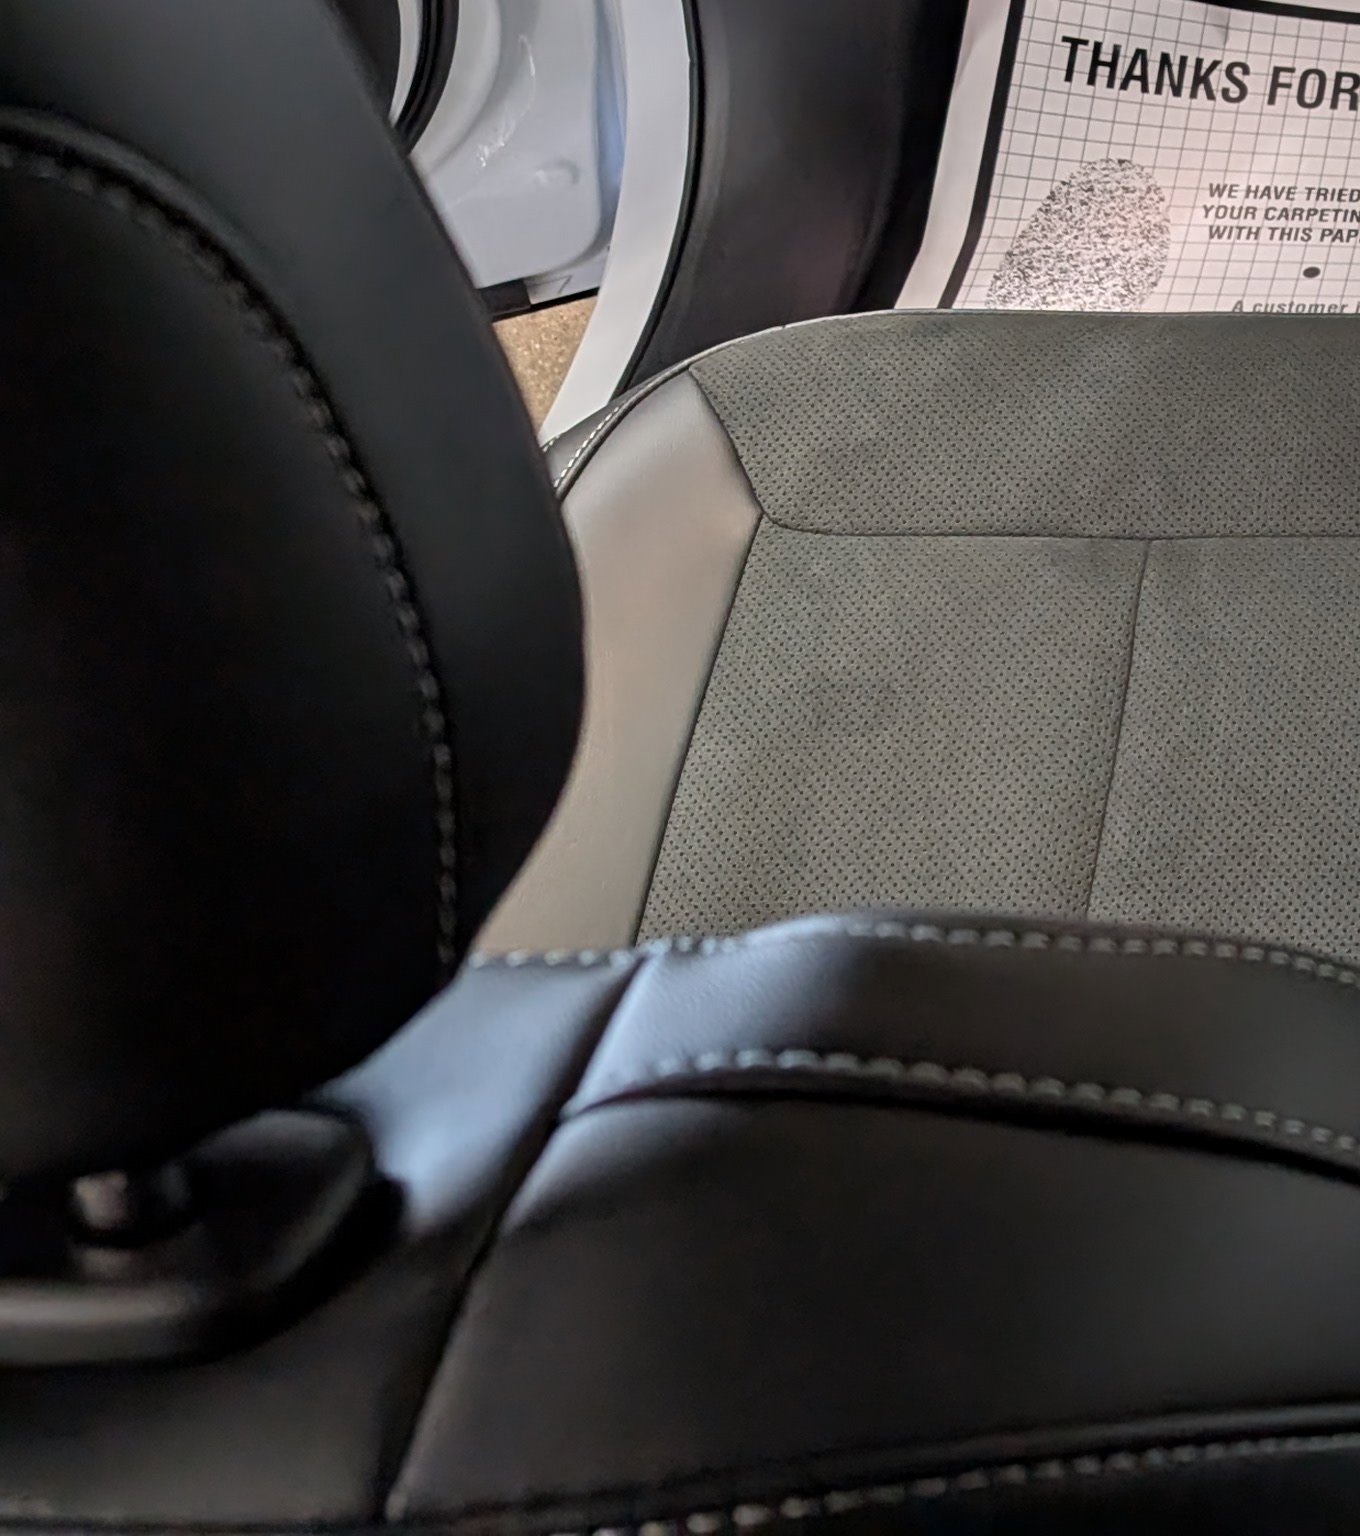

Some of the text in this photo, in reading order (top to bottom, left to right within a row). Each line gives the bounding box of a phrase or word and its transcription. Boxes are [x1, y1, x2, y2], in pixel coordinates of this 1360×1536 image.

[1059, 36, 1251, 104] THANKS
[1208, 183, 1240, 200] WE
[1244, 184, 1298, 201] HAVE
[1202, 204, 1257, 220] YOUR
[1208, 225, 1261, 241] WITH
[1268, 226, 1313, 242] THIS
[1232, 300, 1244, 313] A
[1252, 301, 1348, 314] customer
